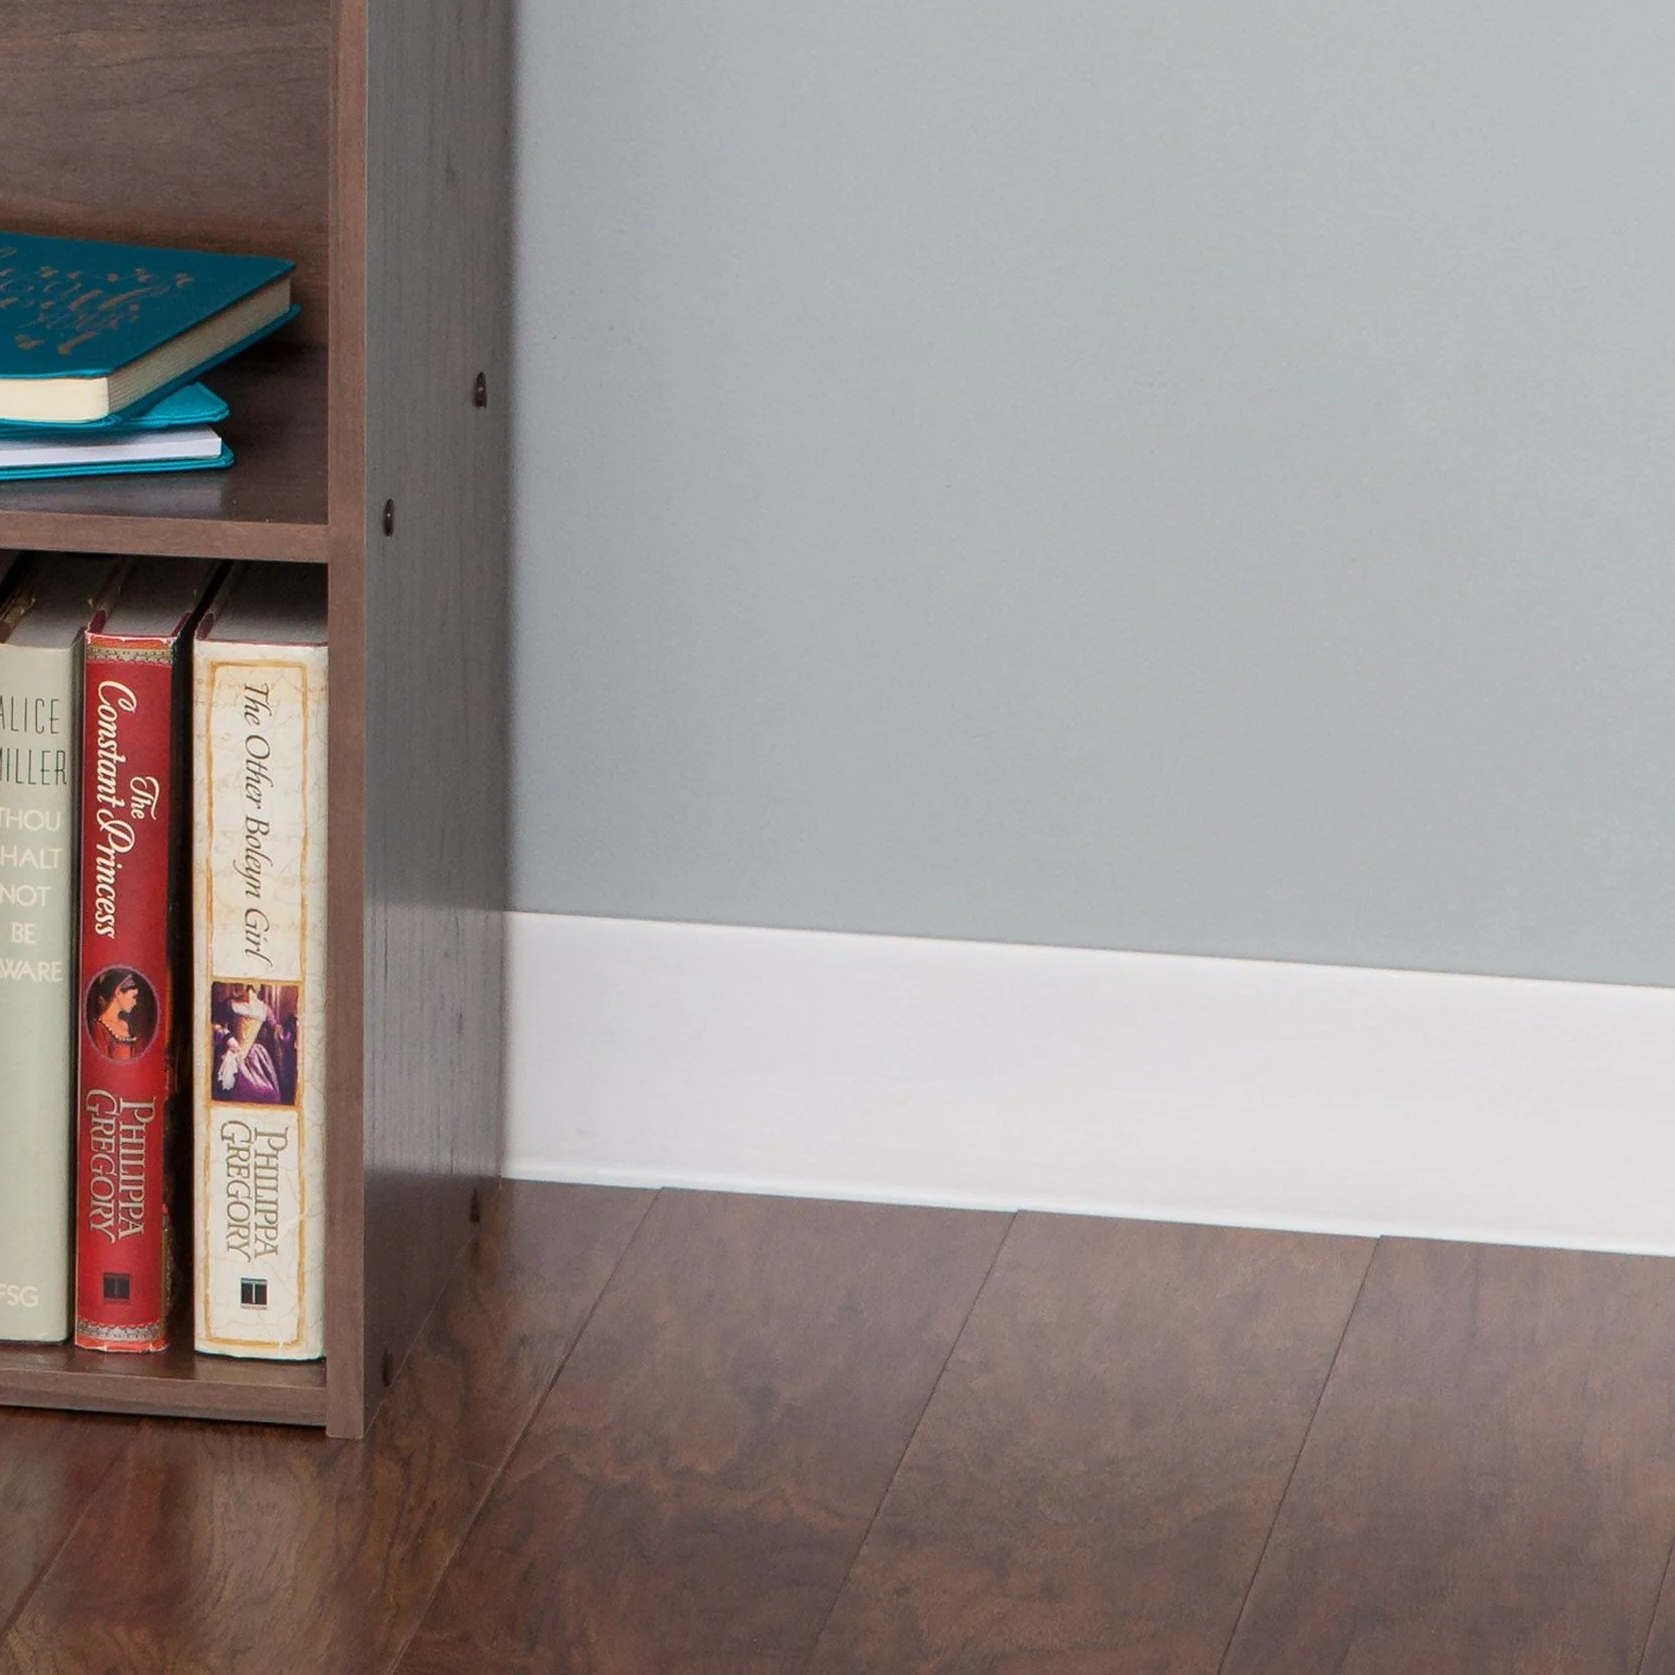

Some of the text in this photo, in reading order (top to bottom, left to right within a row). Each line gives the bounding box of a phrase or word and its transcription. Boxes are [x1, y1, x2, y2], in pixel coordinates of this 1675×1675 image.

[95, 679, 137, 939] Constant Princess
[129, 776, 161, 821] The
[232, 682, 274, 968] The Other Boleyn Girl
[10, 922, 37, 945] BE
[85, 1088, 120, 1244] GREGORY
[118, 1095, 156, 1241] PHILIPPA
[220, 1119, 253, 1263] GREGORY
[254, 1127, 289, 1259] PHILIPPA
